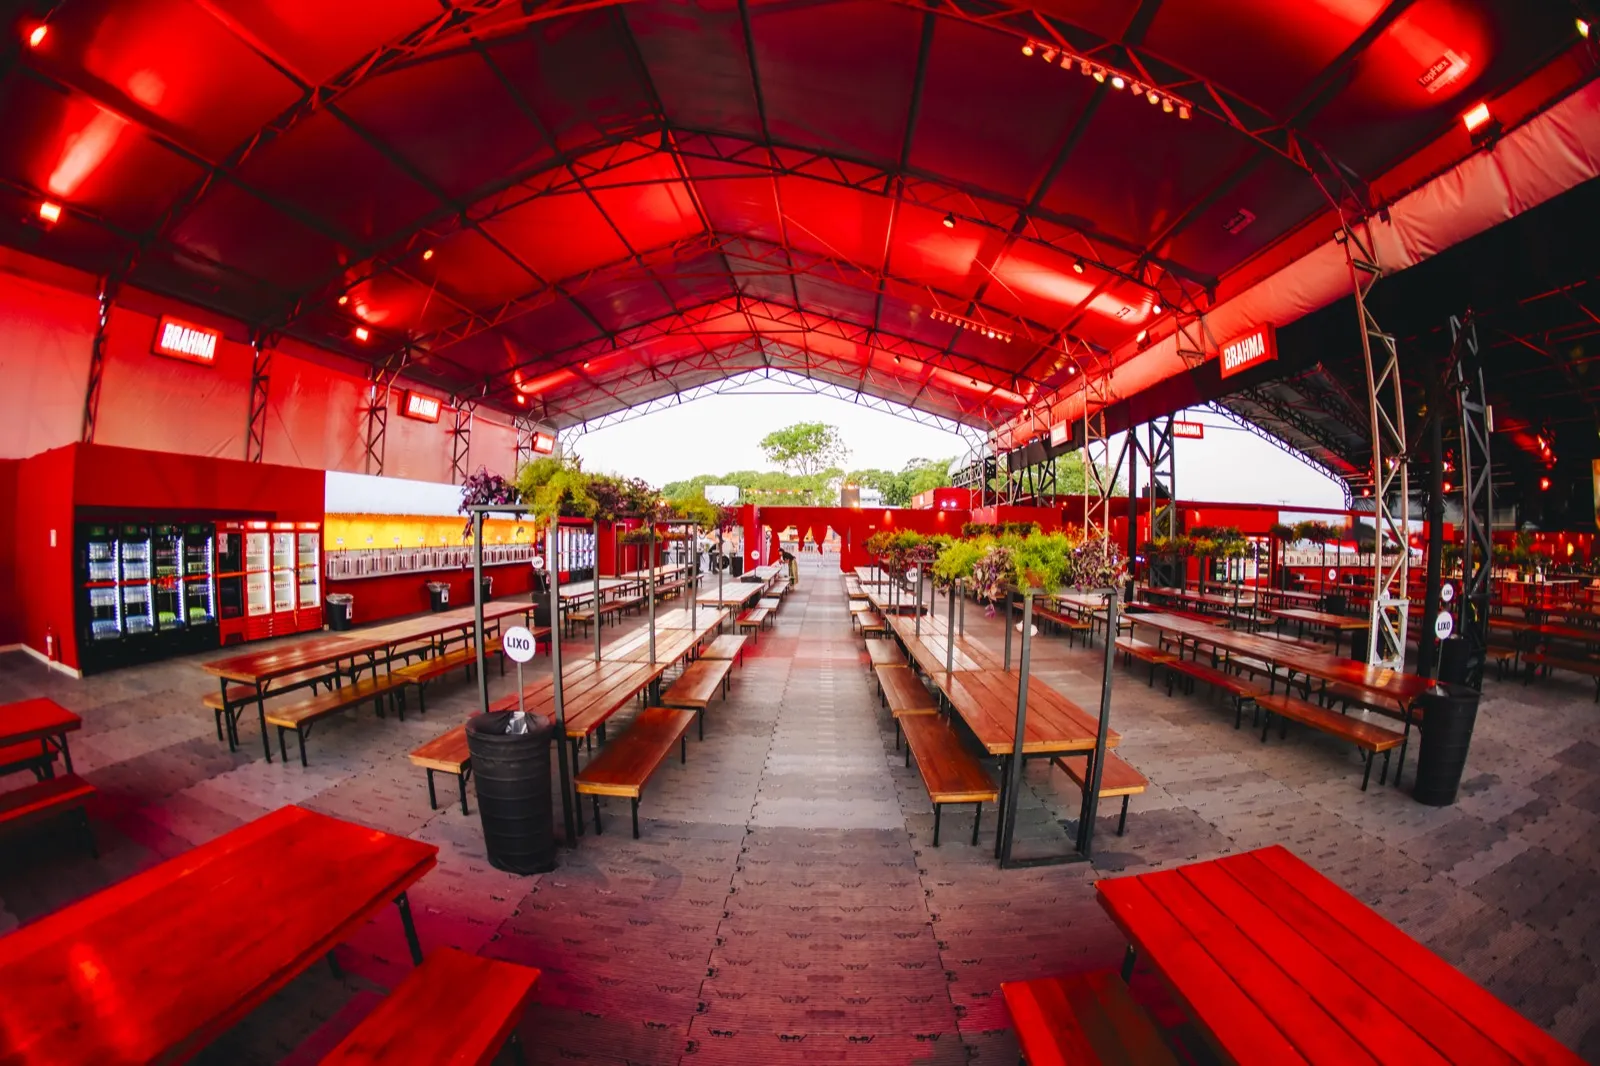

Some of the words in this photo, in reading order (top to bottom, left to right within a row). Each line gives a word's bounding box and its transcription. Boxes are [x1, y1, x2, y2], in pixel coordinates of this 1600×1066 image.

[161, 323, 217, 360] BRAHMA
[1224, 332, 1265, 371] BRAHMA
[1437, 621, 1451, 632] LIXO
[507, 636, 530, 651] LIXO
